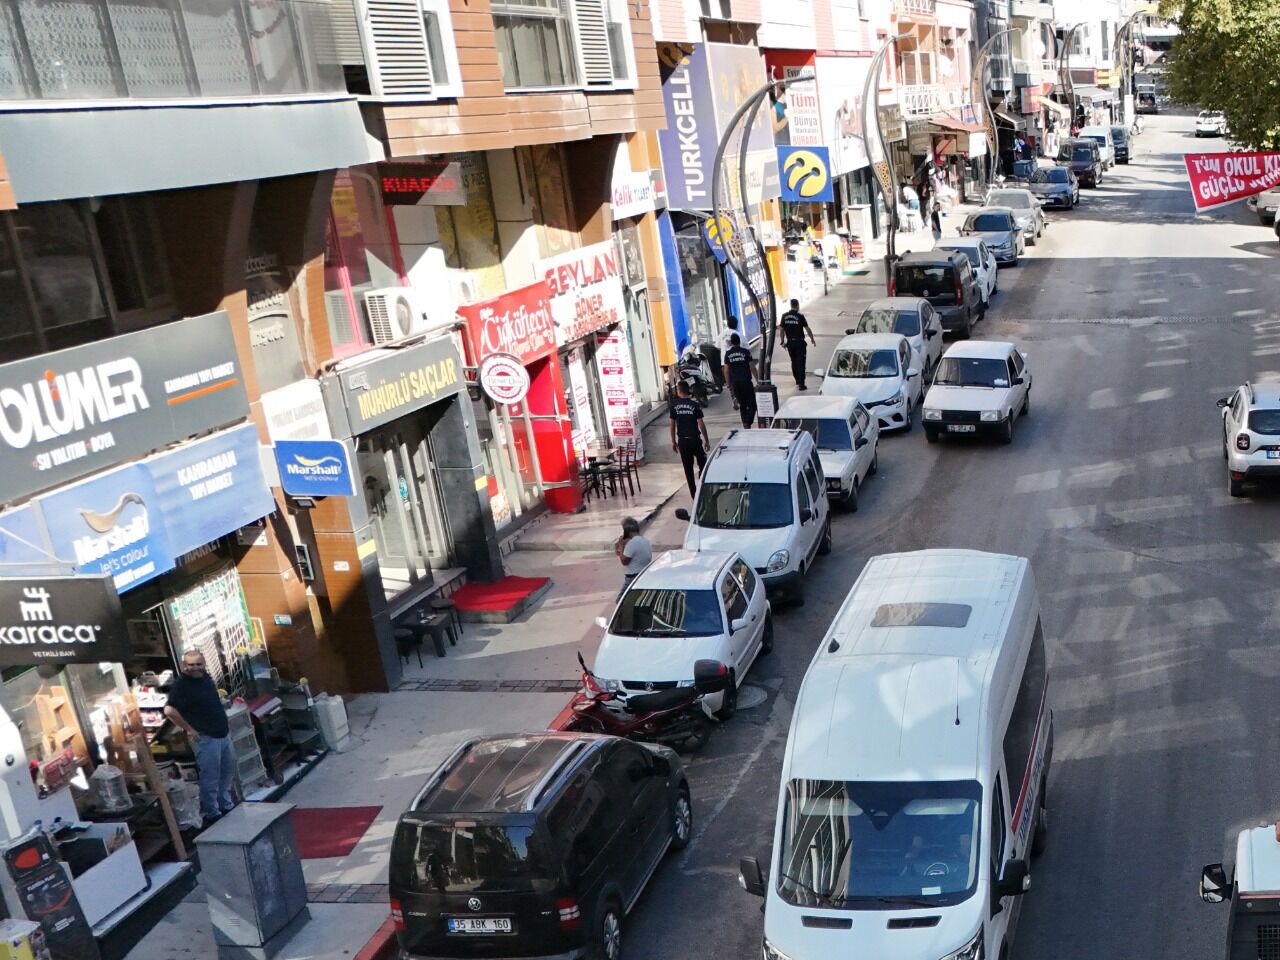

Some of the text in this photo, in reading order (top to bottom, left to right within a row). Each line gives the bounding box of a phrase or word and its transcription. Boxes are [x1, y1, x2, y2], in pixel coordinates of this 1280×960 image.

[670, 68, 706, 201] TURKCELL
[1192, 156, 1261, 177] TÜM OKUL
[177, 450, 237, 487] KAHRAMAN
[287, 463, 339, 476] Marshall
[73, 515, 149, 566] Marshall
[454, 919, 509, 930] 35 ABK 160
